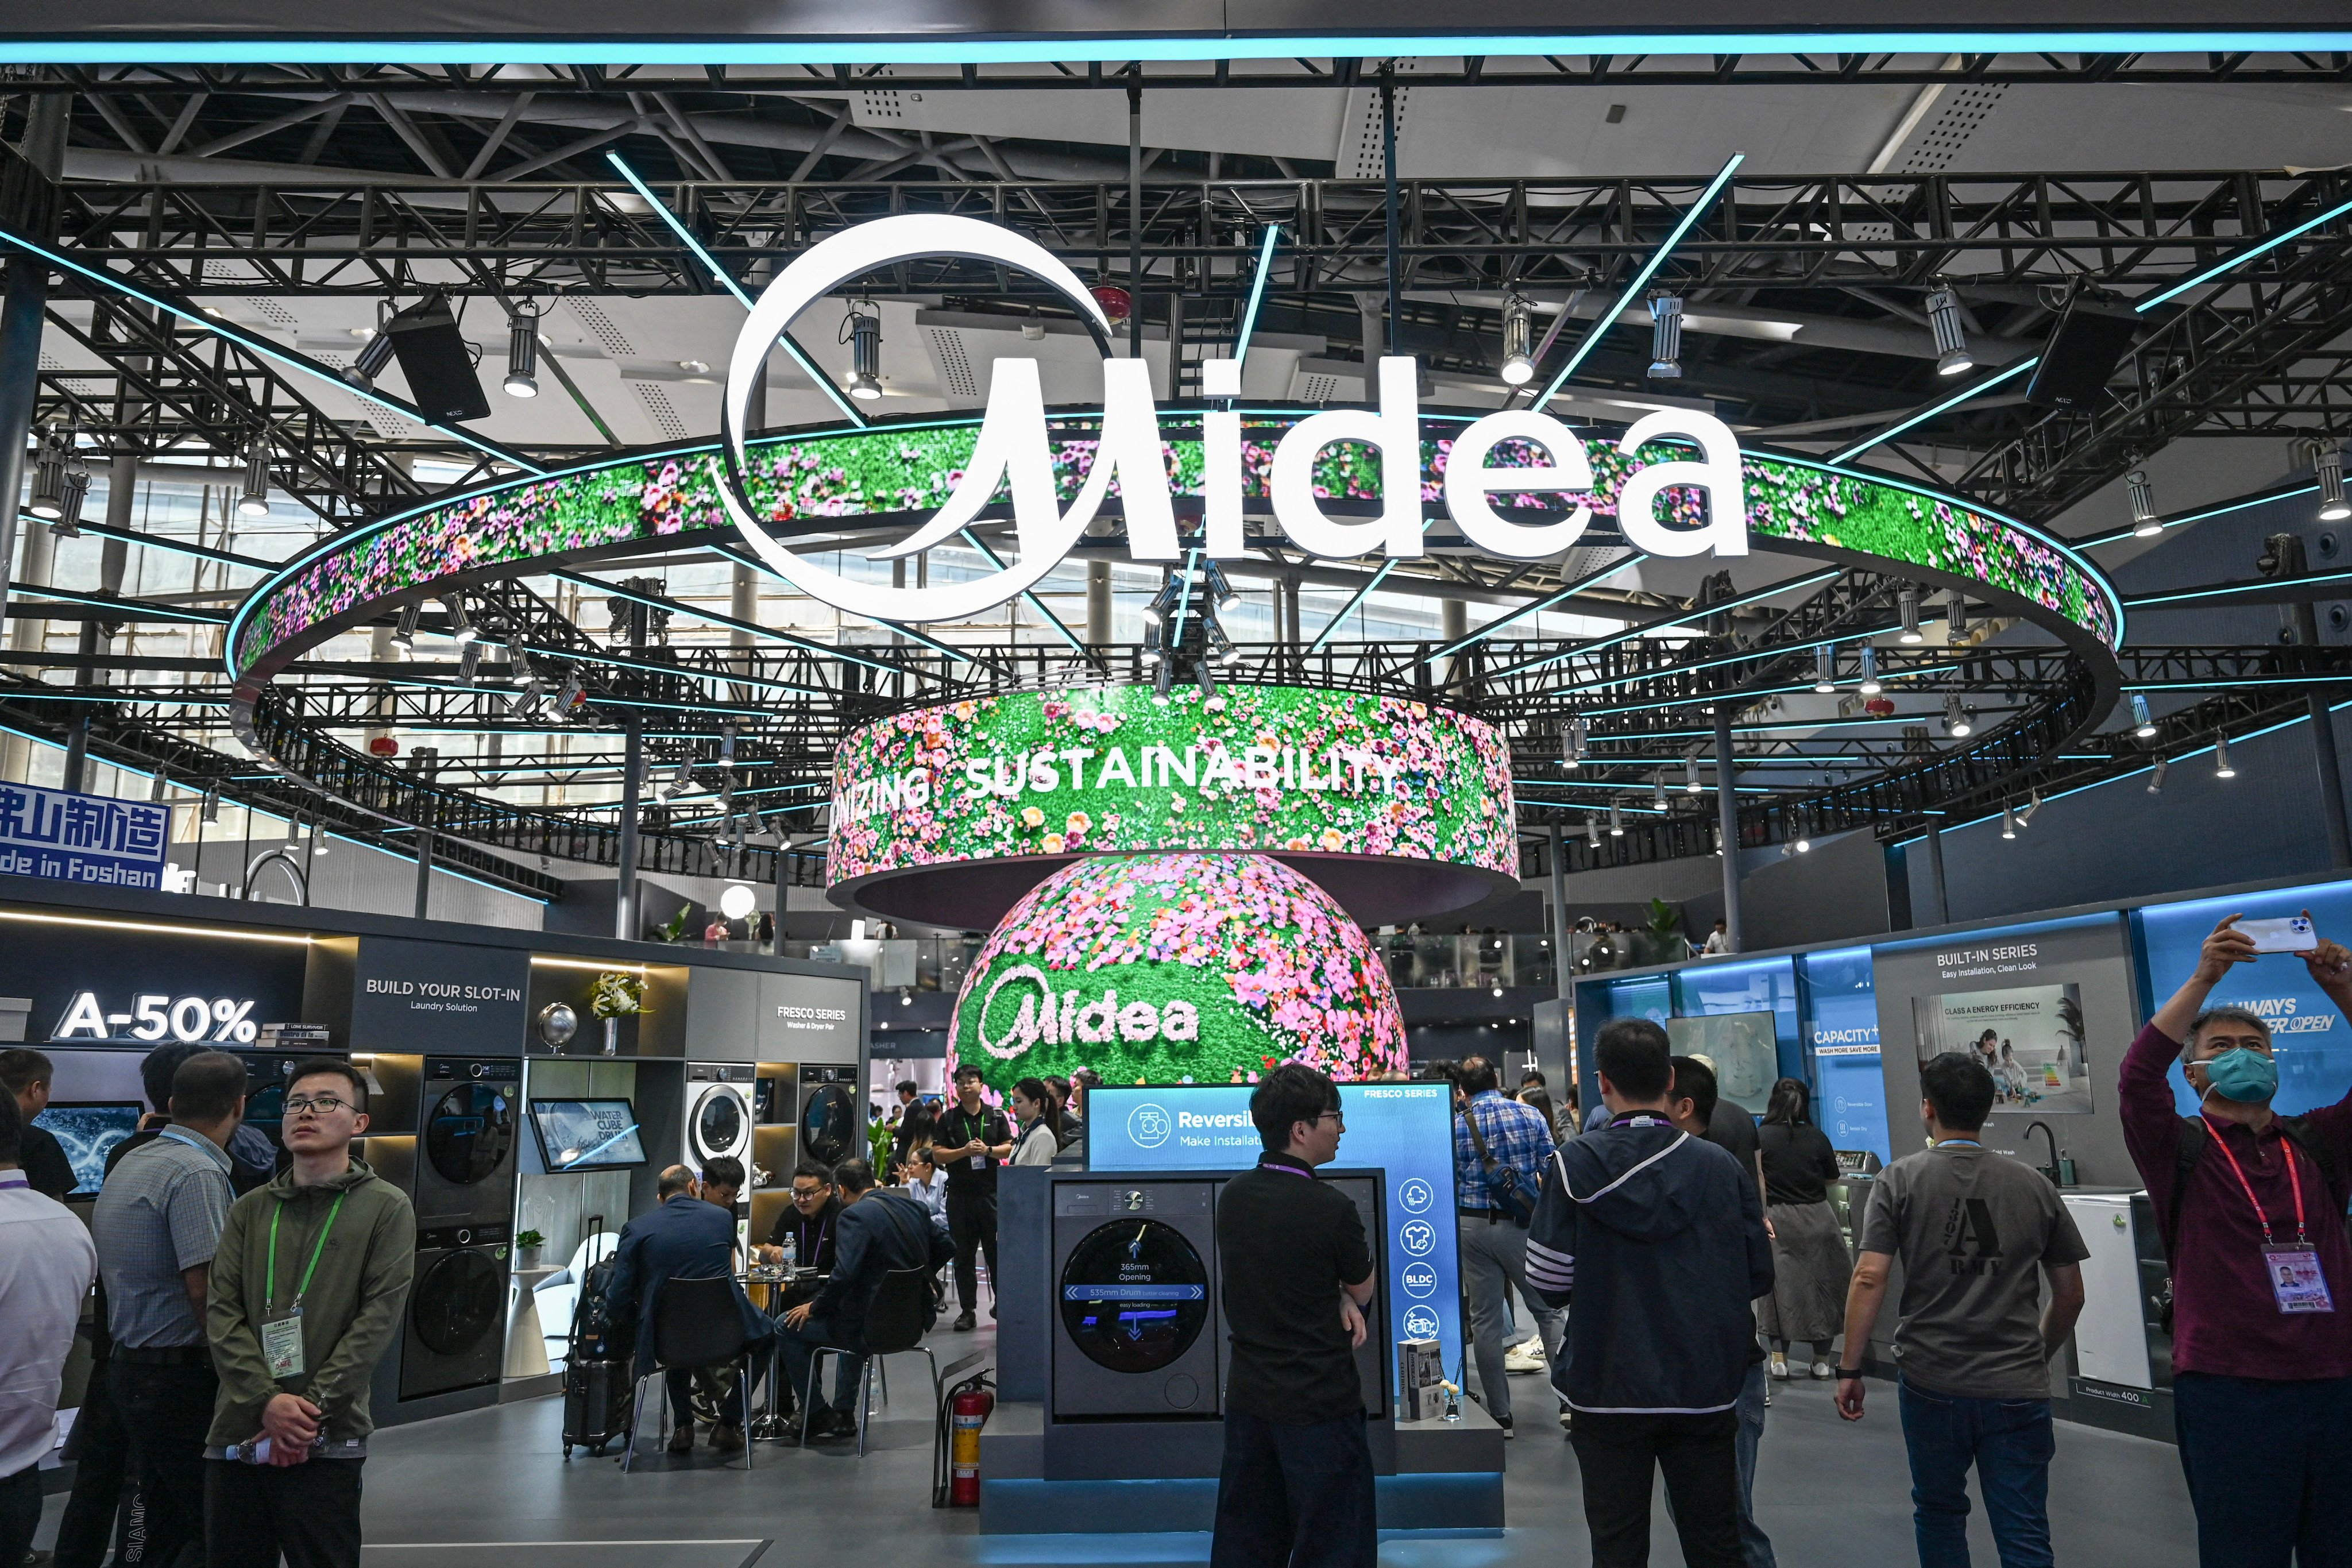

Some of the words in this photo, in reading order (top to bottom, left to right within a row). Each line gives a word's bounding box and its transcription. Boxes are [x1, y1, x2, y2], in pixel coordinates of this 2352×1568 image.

[710, 214, 1748, 622] Midea
[965, 746, 1400, 799] SUSTAINABILITY
[40, 854, 60, 877] in
[68, 858, 156, 888] Foshan
[1937, 949, 1989, 966] BUILT-IN
[1992, 944, 2037, 960] SERIES
[1959, 967, 1996, 976] Installation,
[1998, 964, 2017, 972] Clean
[2018, 961, 2036, 970] Look
[366, 979, 414, 995] BUILD
[418, 983, 460, 998] YOUR
[464, 987, 520, 1002] SLOT-IN
[411, 1001, 443, 1011] Laundry
[446, 1003, 477, 1012] Solution
[778, 1006, 814, 1018] FRESCO
[816, 1009, 845, 1021] SERIES
[978, 965, 1199, 1059] Midea
[1972, 1005, 1999, 1013] ENERGY
[2000, 1002, 2040, 1011] EFFICIENCY
[57, 990, 257, 1042] A-50%
[2291, 1015, 2335, 1031] OPEN
[1364, 1090, 1403, 1098] FRESCO
[1404, 1089, 1437, 1098] SERIES
[590, 1111, 623, 1119] WATER
[597, 1121, 623, 1130] CUBE
[1180, 1134, 1210, 1146] Make
[1119, 1273, 1151, 1281] Opening
[1406, 1275, 1433, 1283] BLDC
[2085, 1387, 2104, 1396] Product
[2106, 1391, 2120, 1399] Width
[2122, 1391, 2139, 1402] 400
